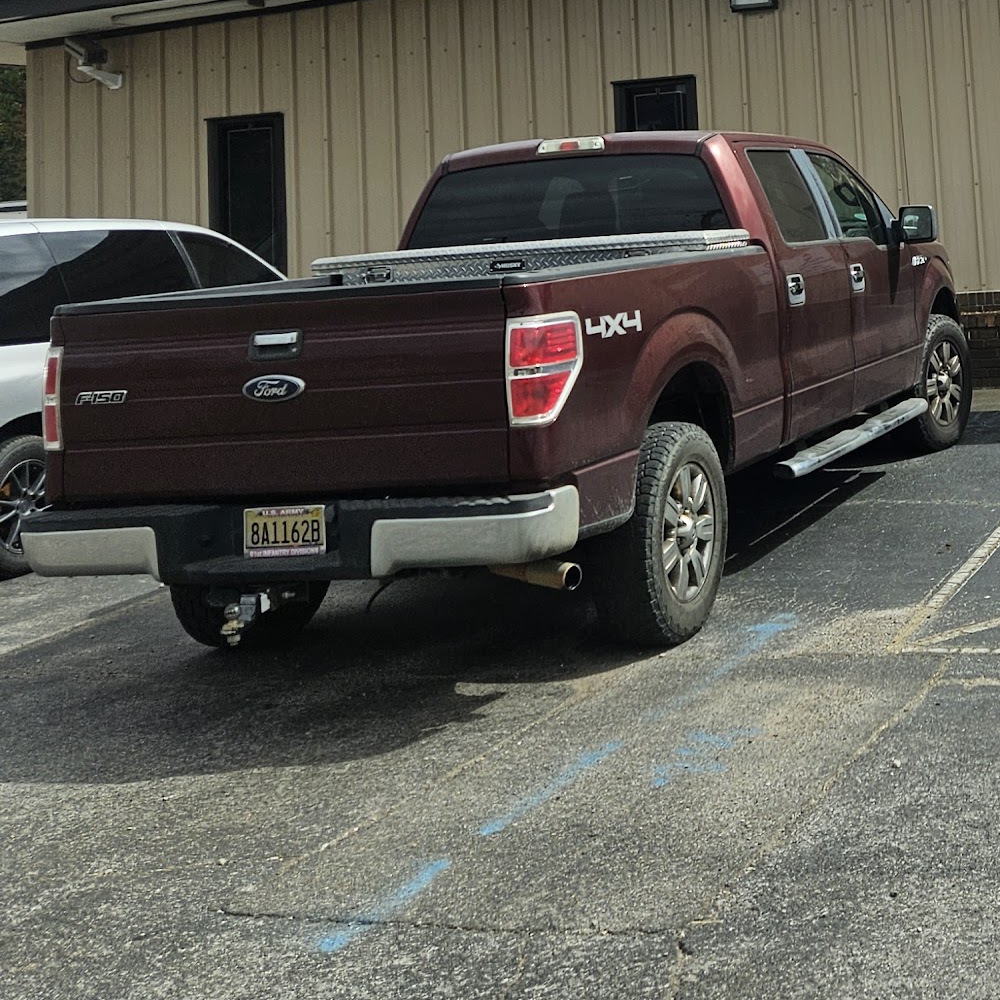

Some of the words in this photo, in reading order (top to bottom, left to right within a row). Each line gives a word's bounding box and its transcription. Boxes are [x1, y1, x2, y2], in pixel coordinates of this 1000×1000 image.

[253, 380, 287, 397] Ford
[262, 509, 279, 517] U.S.
[280, 508, 305, 517] ARMY
[251, 519, 321, 546] 8A1162B
